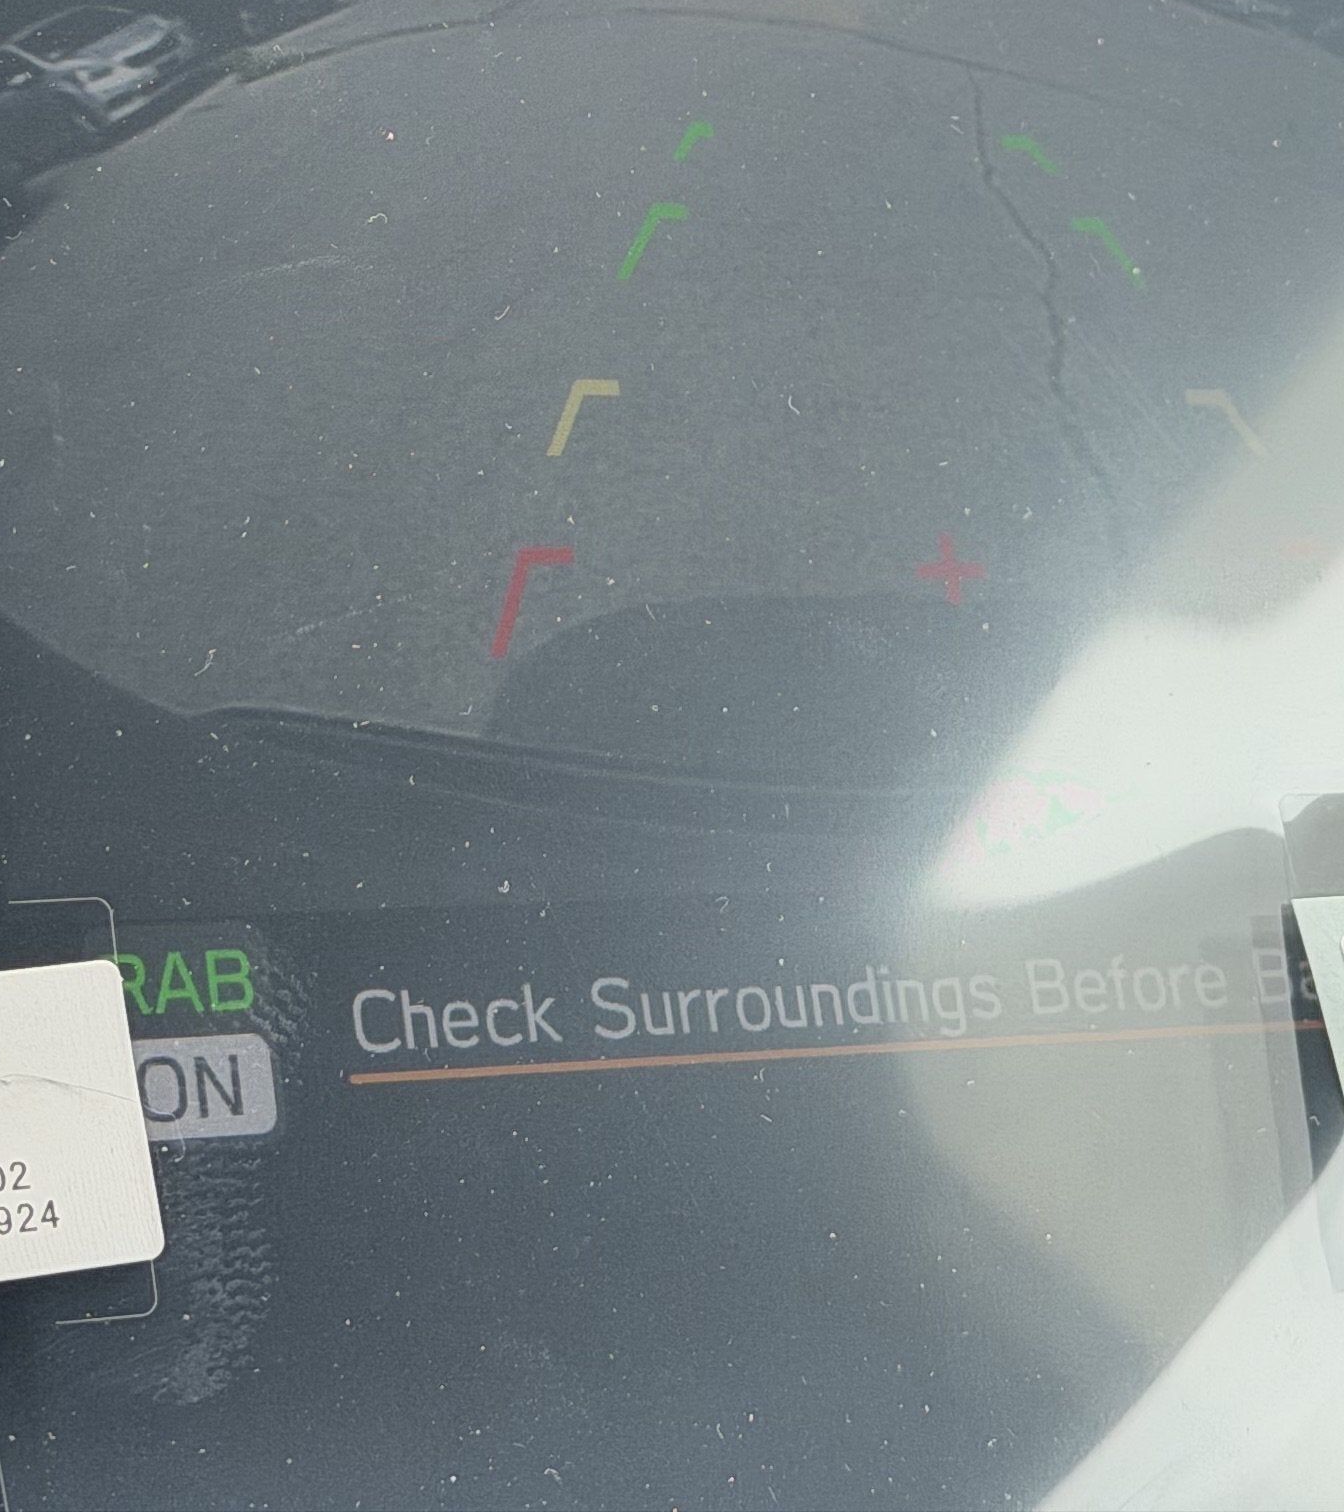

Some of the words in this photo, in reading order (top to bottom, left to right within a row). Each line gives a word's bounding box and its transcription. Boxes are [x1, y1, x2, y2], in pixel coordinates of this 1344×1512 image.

[115, 949, 254, 1015] RAB
[353, 984, 563, 1053] Check
[591, 958, 1003, 1039] Surroundings
[1025, 955, 1227, 1016] Before
[137, 1055, 244, 1122] ON
